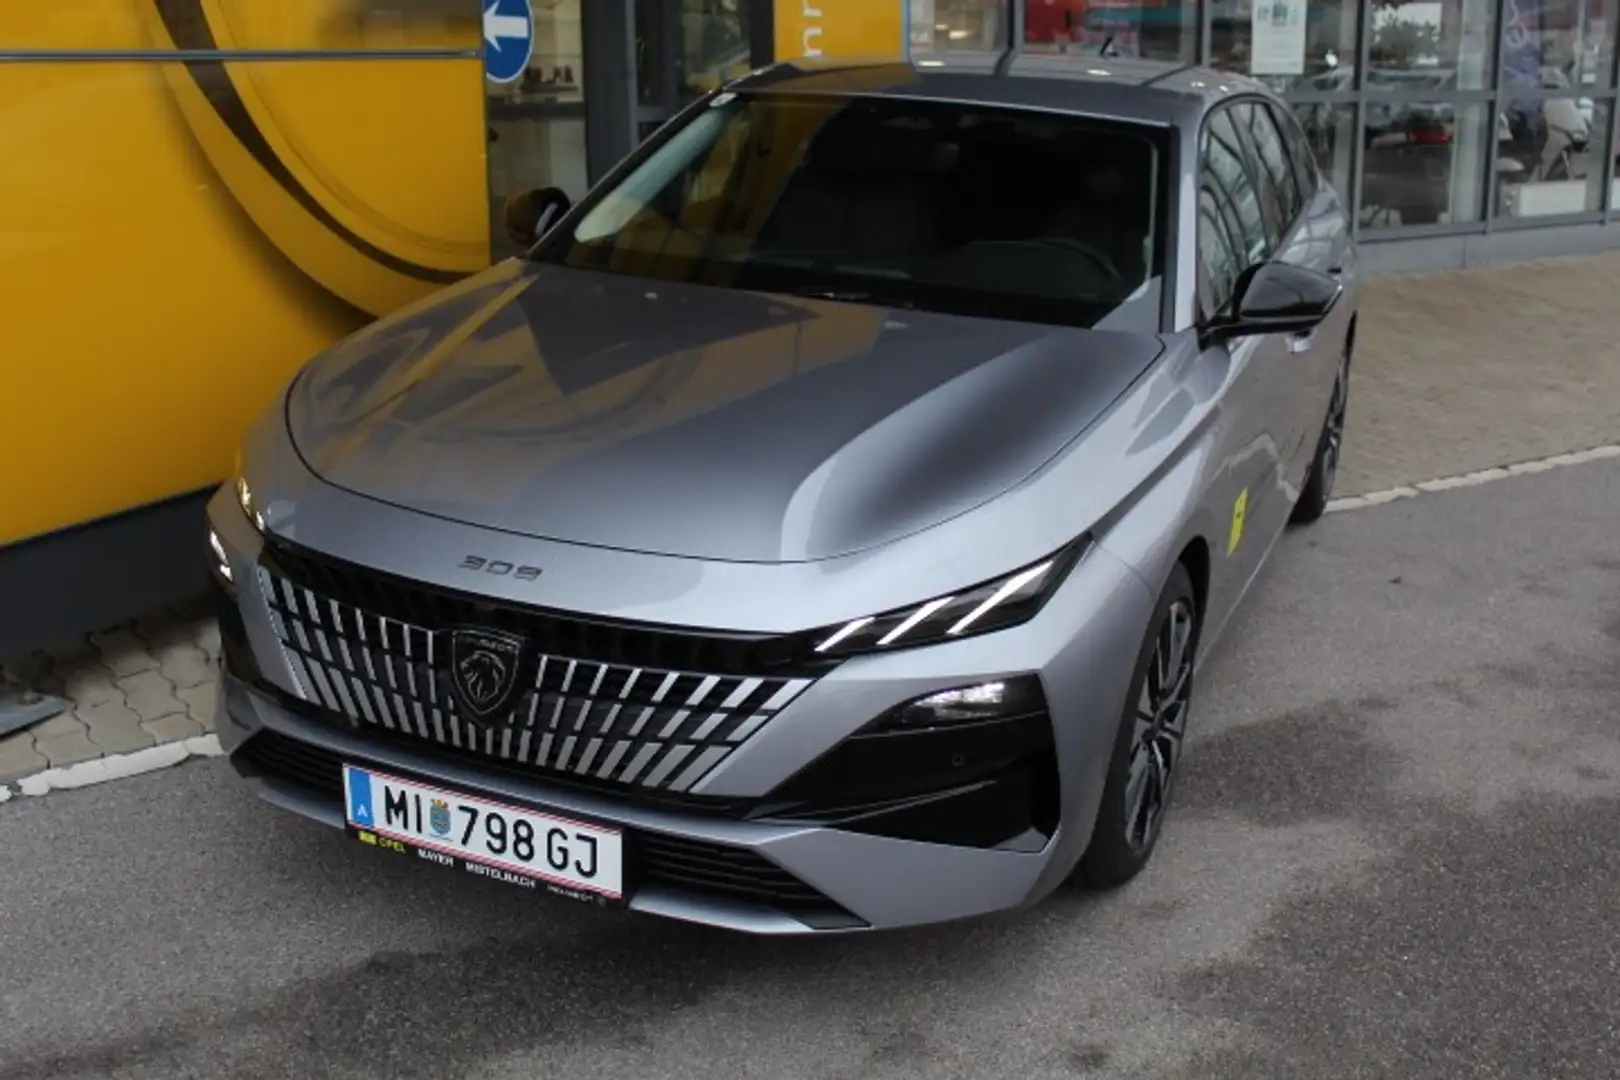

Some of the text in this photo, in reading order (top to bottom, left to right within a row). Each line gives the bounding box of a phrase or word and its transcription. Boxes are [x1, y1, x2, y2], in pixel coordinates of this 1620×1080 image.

[458, 555, 543, 581] 308
[385, 785, 598, 878] MI 798 GJ
